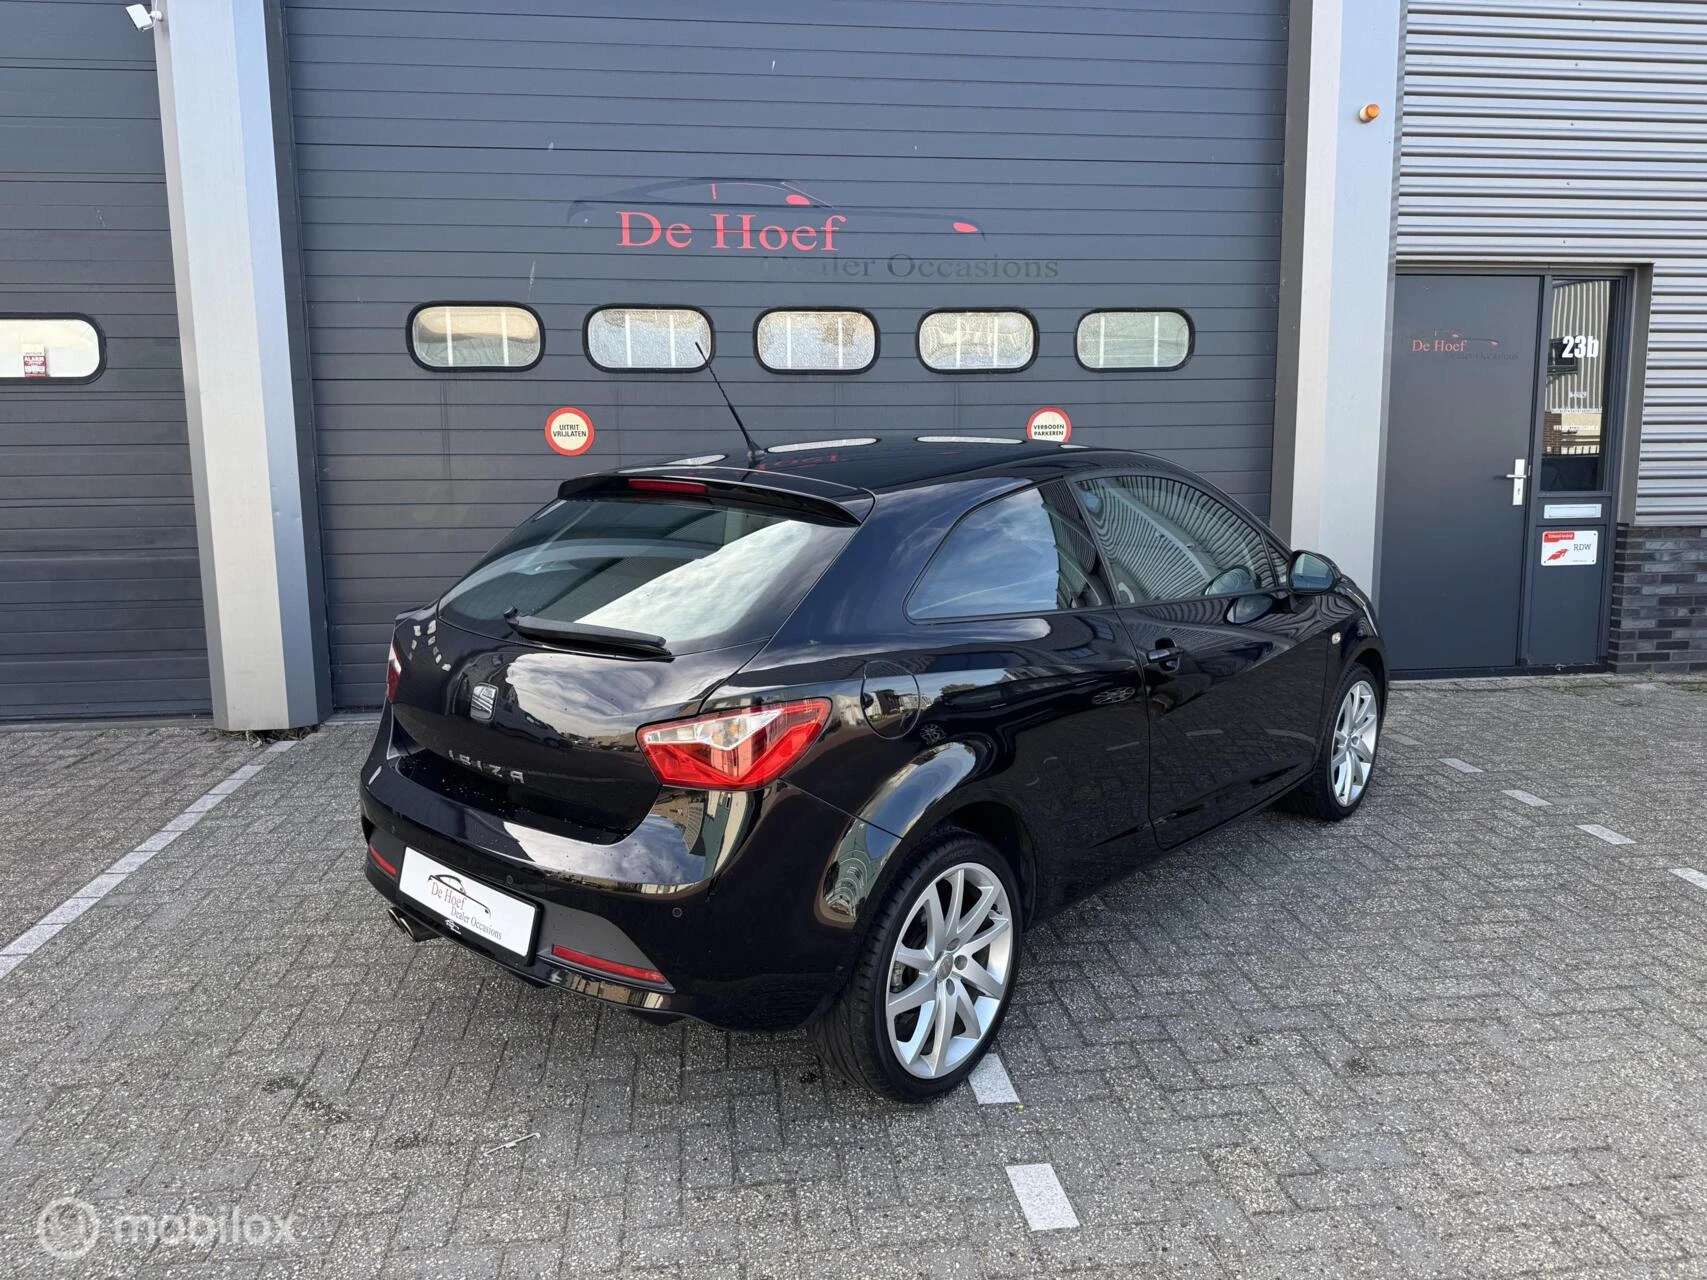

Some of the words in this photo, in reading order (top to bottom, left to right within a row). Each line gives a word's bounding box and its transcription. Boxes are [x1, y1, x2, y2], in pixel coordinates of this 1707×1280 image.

[616, 211, 693, 249] De
[709, 213, 848, 251] Hoef
[886, 252, 1060, 280] Occasions
[1411, 338, 1431, 352] De
[1433, 338, 1468, 352] Hoef
[1561, 335, 1600, 359] 23b
[1573, 543, 1592, 551] RDW
[431, 881, 443, 899] De
[444, 888, 467, 911] Hoef
[450, 906, 470, 924] Dealer
[470, 916, 503, 941] Occasions
